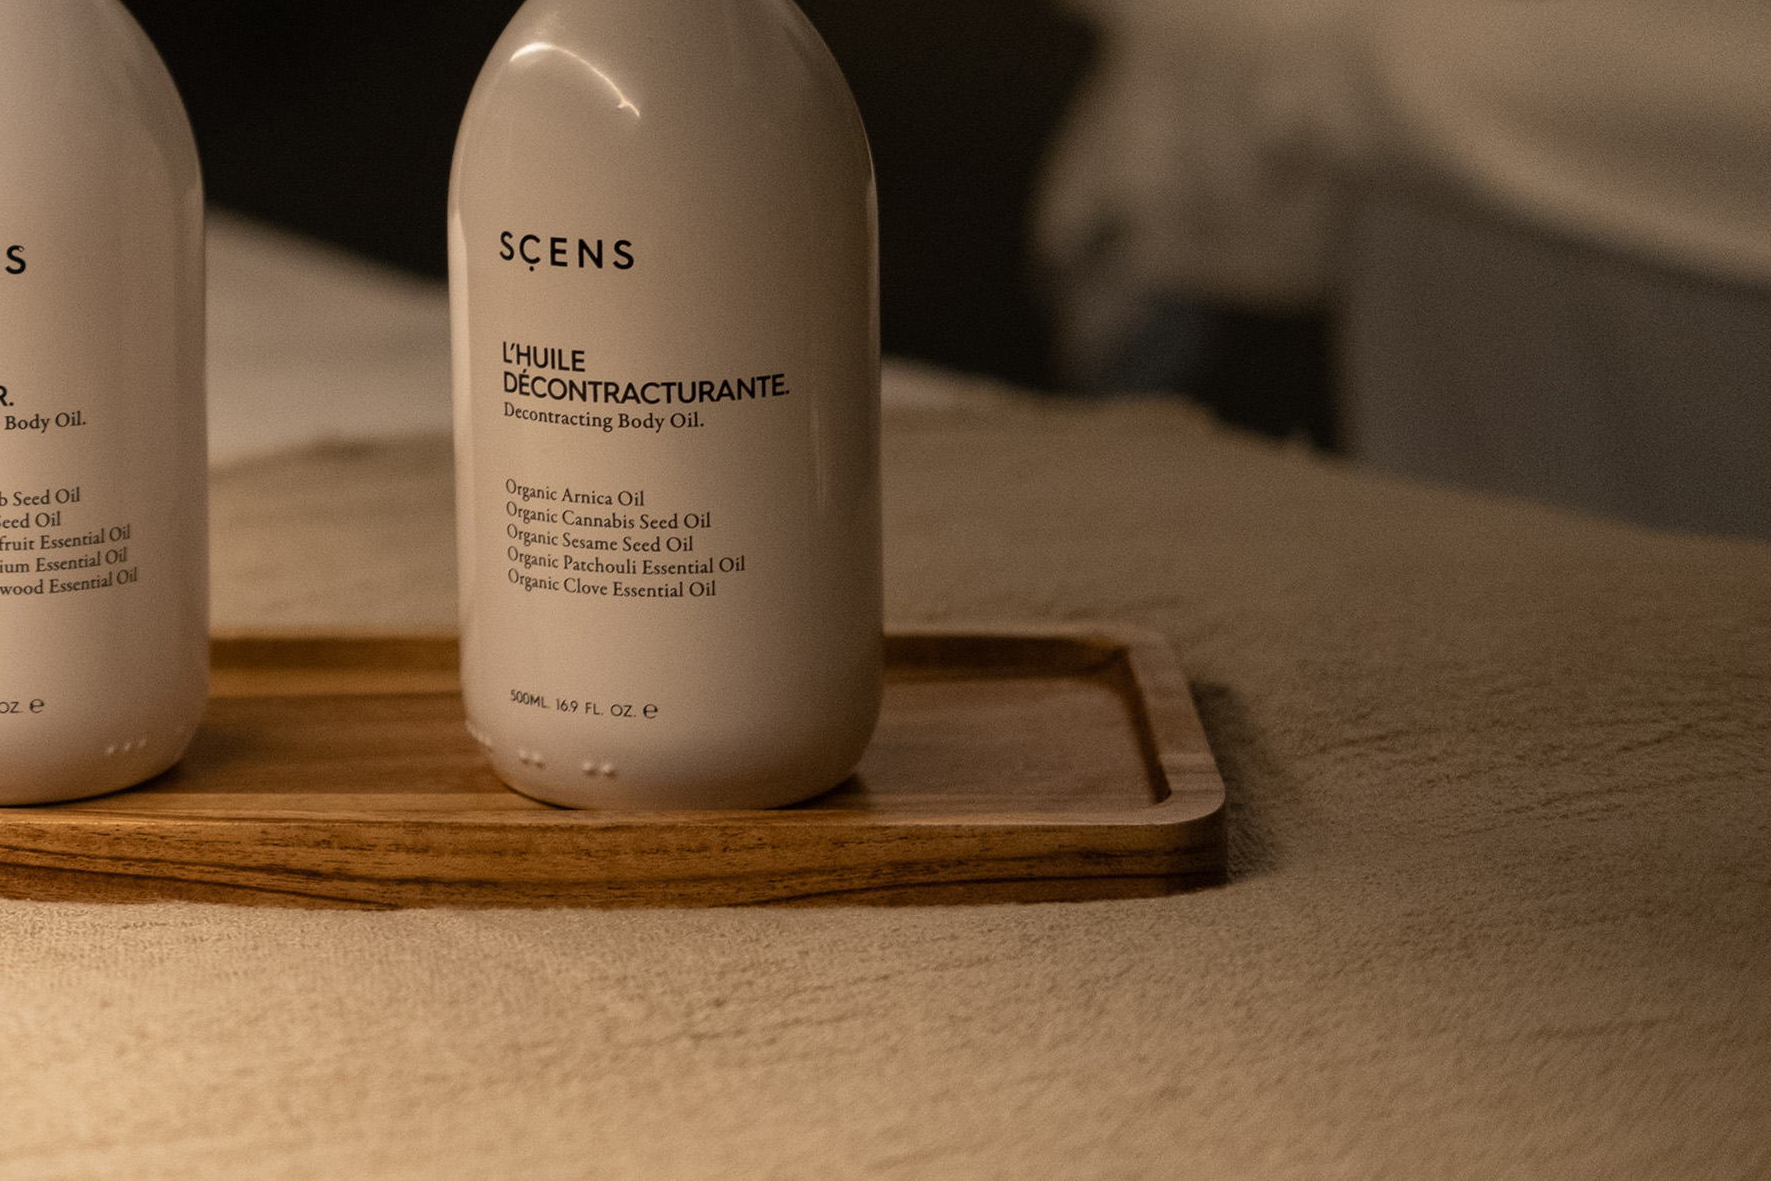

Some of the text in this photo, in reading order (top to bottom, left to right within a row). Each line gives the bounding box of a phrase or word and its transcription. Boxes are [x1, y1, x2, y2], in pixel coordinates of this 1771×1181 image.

[502, 341, 586, 373] L'HUILE
[503, 368, 790, 405] DÉCONTRACTURANTE.
[3, 413, 51, 434] Body
[54, 410, 87, 428] Oil.
[503, 401, 705, 434] Decontracting Body Oil.
[12, 488, 51, 507] Seed
[54, 486, 81, 505] Oil
[505, 478, 645, 507] Organic Arnica Oil
[34, 510, 62, 528] Oil
[505, 500, 712, 530] Organic Cannabis Seed Oil
[39, 528, 106, 550] Essential
[108, 524, 132, 542] Oil
[506, 523, 694, 553] Organic Sesame Seed Oil
[34, 550, 101, 573] Essential
[104, 546, 128, 565] Oil
[507, 545, 746, 576] Organic Patchouli Essential Oil
[48, 571, 113, 595] Essential
[116, 566, 139, 585] Oil
[507, 567, 717, 598] Organic Clove Essential Oil
[555, 698, 579, 713] 16.9
